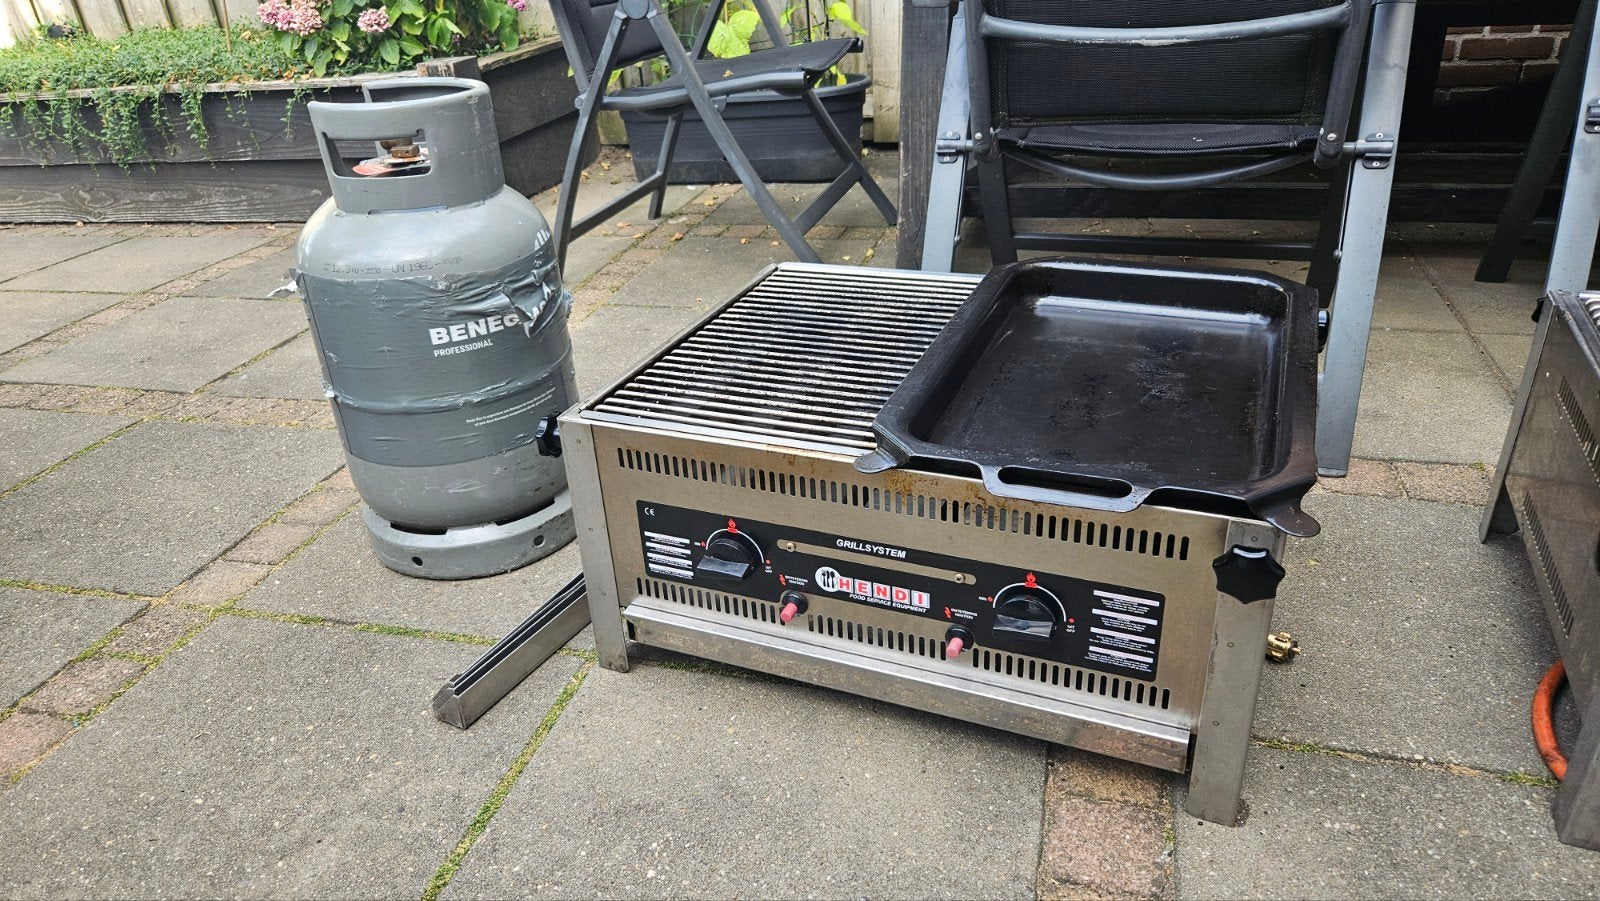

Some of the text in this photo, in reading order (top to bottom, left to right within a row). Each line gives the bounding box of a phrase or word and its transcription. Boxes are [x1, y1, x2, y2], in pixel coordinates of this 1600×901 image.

[429, 308, 538, 346] BENEG
[433, 338, 494, 358] PROFESSIONAL
[836, 539, 907, 559] GRILLSYSTEM
[838, 577, 925, 606] HENDI
[849, 593, 927, 614] FOOD SERVICE EQUIPMENT
